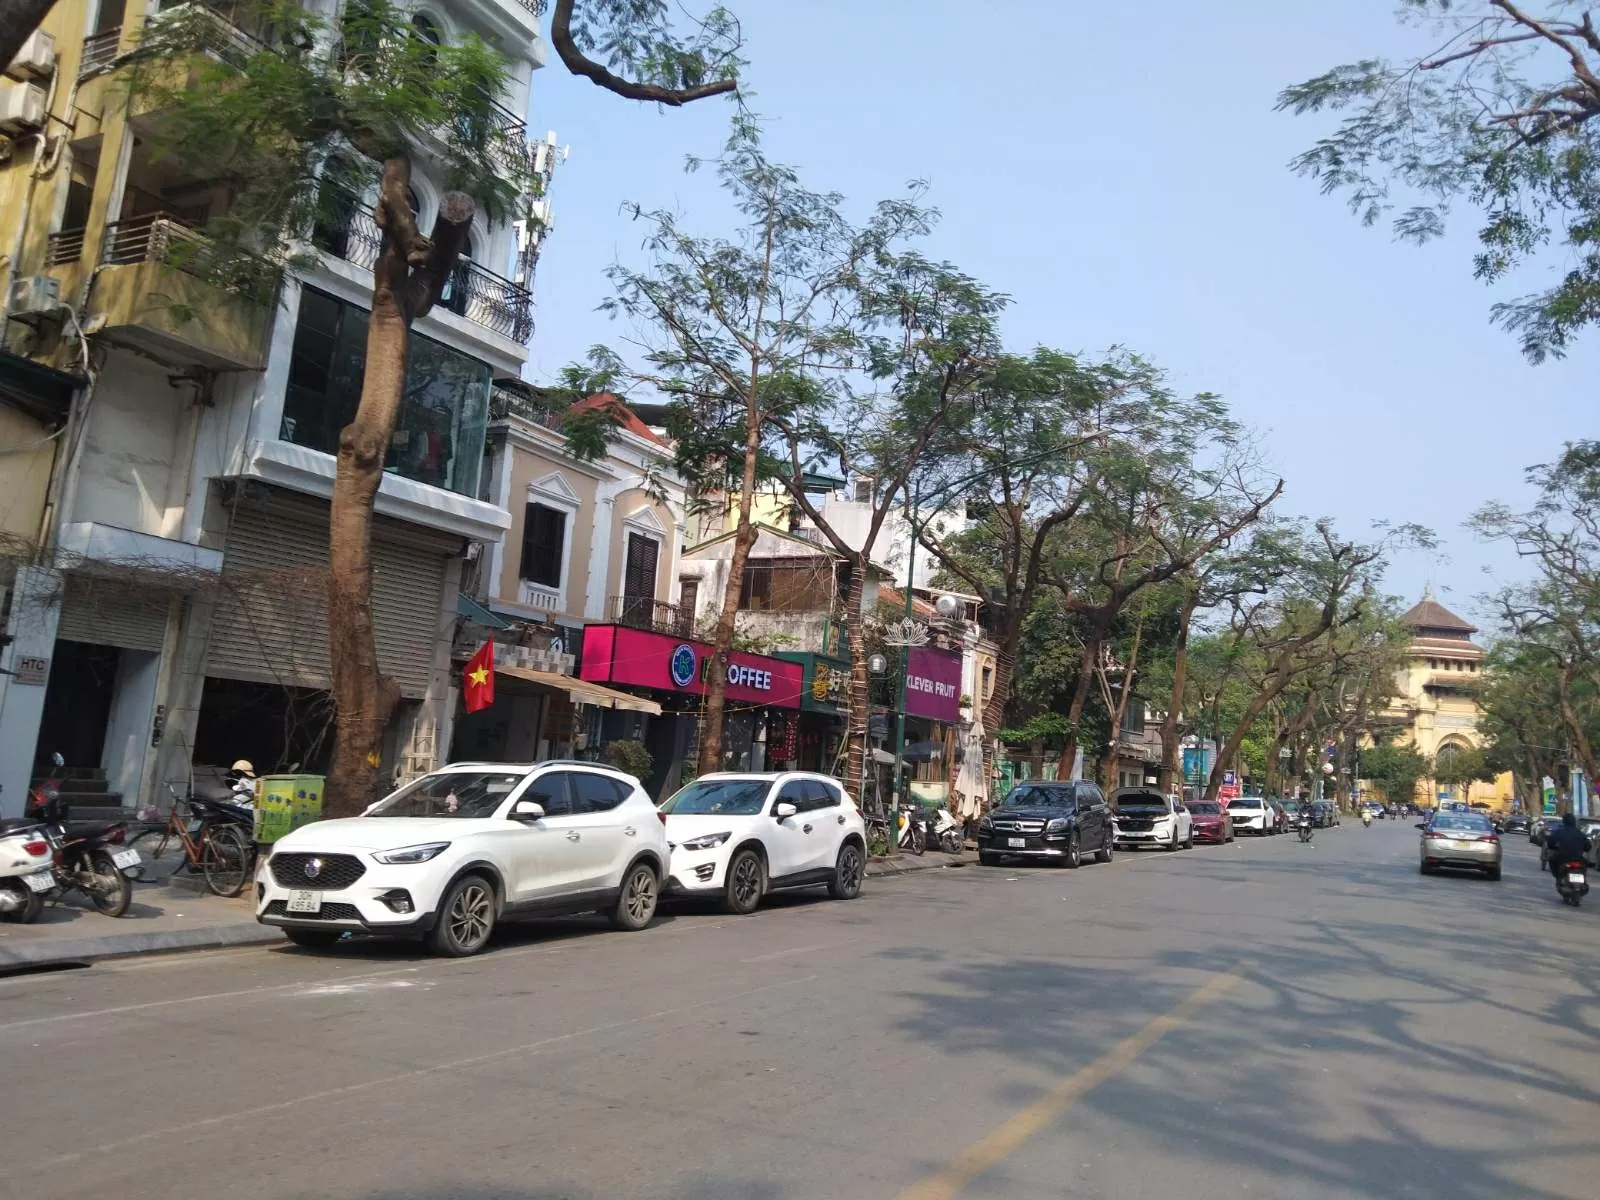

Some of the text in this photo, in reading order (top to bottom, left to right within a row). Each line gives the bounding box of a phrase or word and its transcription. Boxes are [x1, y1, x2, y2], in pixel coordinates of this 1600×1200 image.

[21, 658, 46, 671] HTC
[725, 664, 772, 690] OFFEE
[906, 674, 956, 698] KLEVER FRUIT
